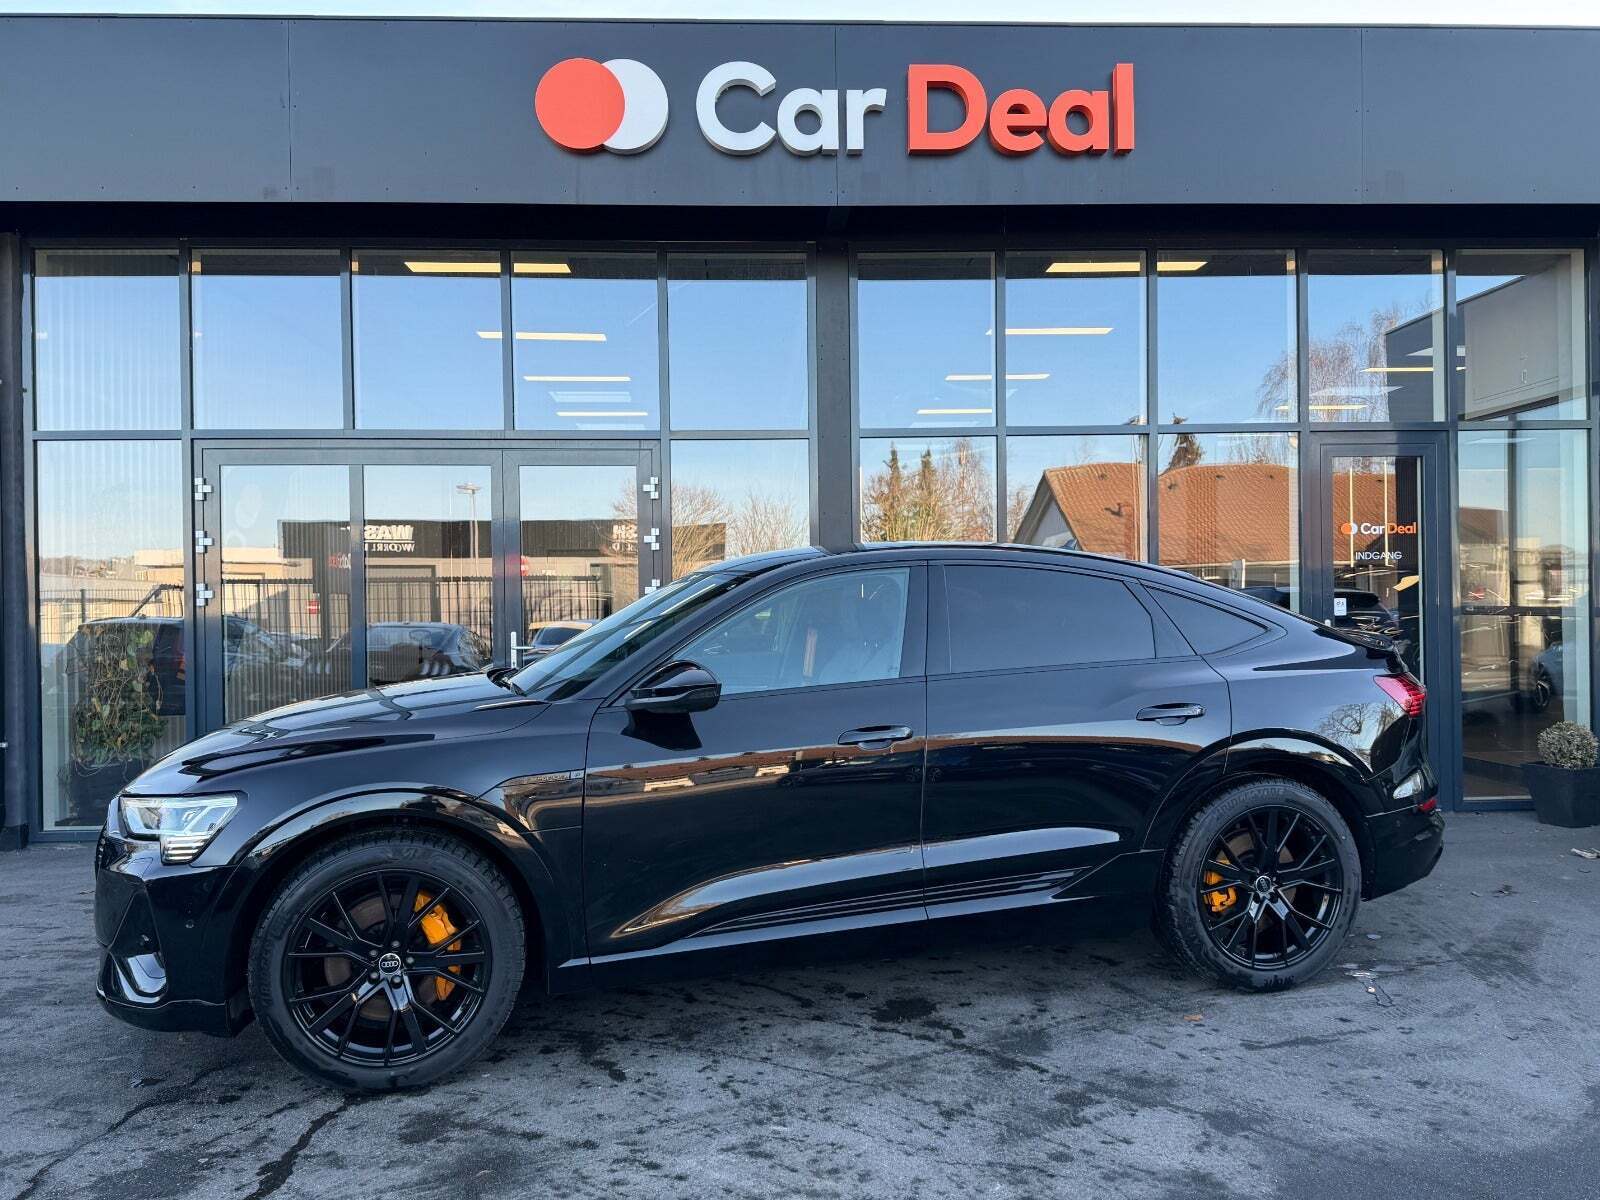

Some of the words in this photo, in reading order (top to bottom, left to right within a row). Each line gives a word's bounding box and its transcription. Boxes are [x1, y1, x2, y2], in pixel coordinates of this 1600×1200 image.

[696, 61, 887, 156] Car
[907, 63, 1135, 156] Deal
[1360, 522, 1385, 535] Car
[1387, 521, 1417, 535] Deal
[1355, 551, 1403, 561] INDGANG
